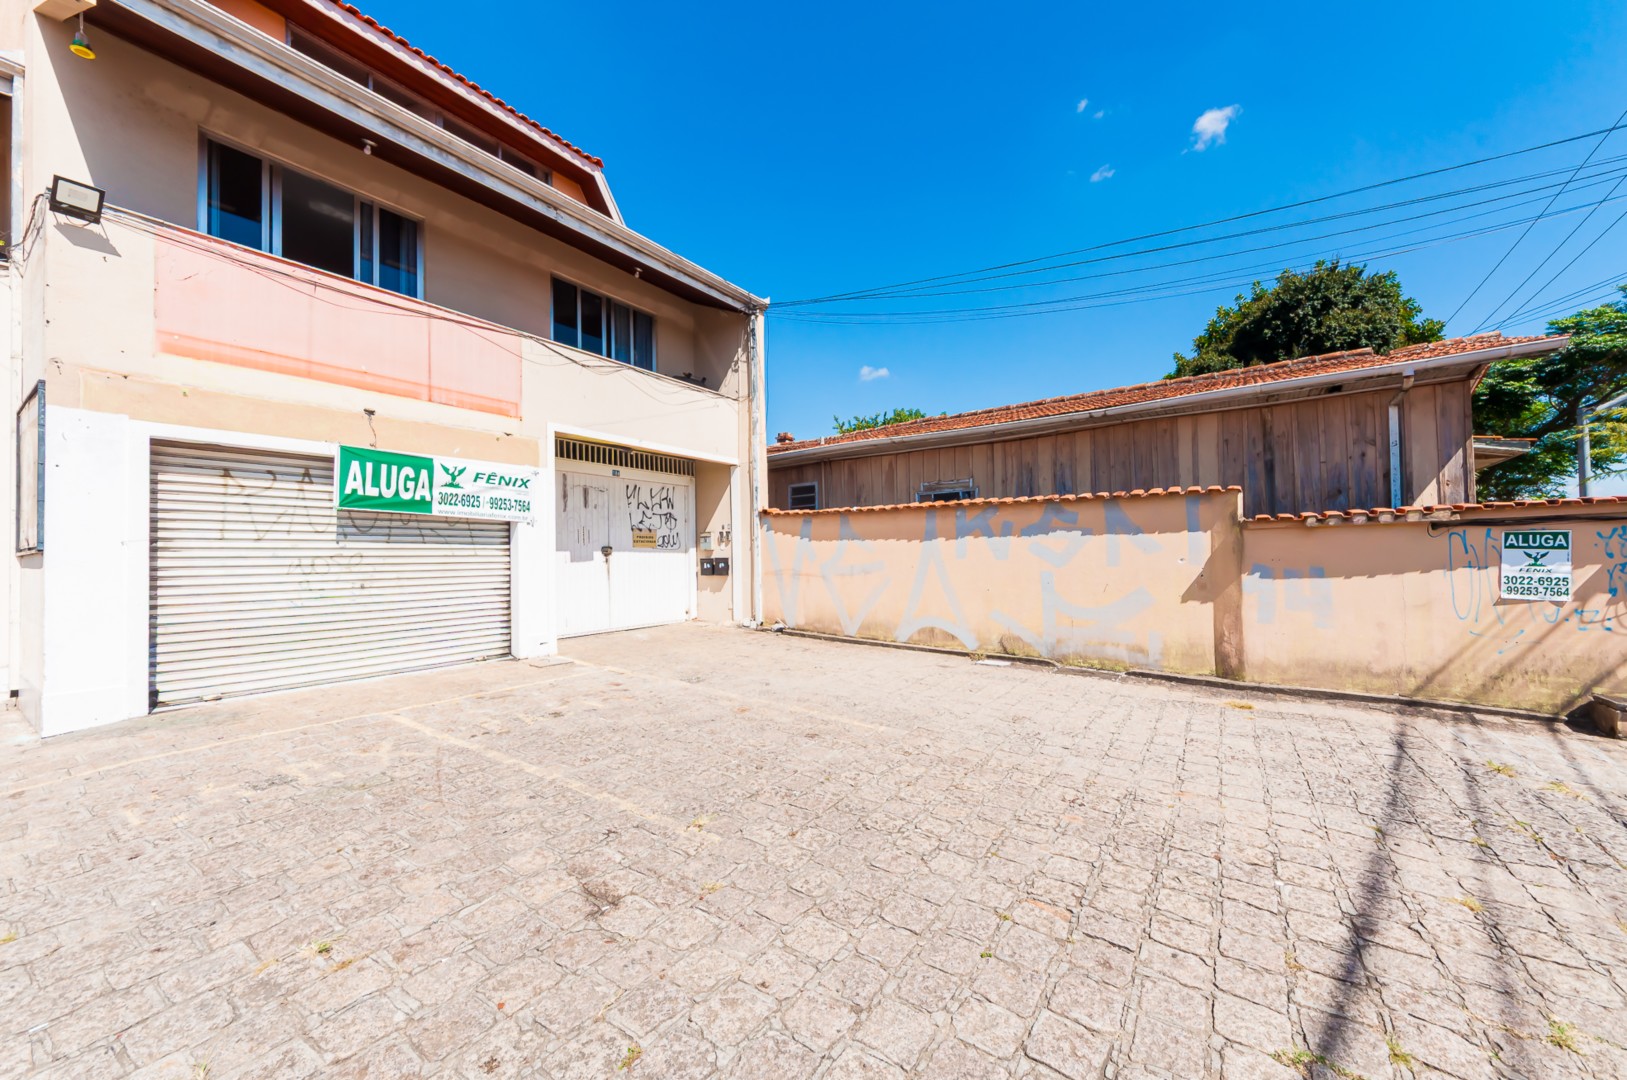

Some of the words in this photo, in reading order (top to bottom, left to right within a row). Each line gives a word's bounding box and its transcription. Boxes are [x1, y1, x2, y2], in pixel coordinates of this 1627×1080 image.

[344, 460, 432, 502] ALUGA
[472, 472, 532, 489] FÊNIX
[438, 491, 481, 509] 3022-6925
[489, 496, 531, 513] 99253-7564
[1505, 534, 1568, 547] ALUGA
[1503, 575, 1569, 587] 3022-6925
[1506, 586, 1570, 597] 99253-7564
